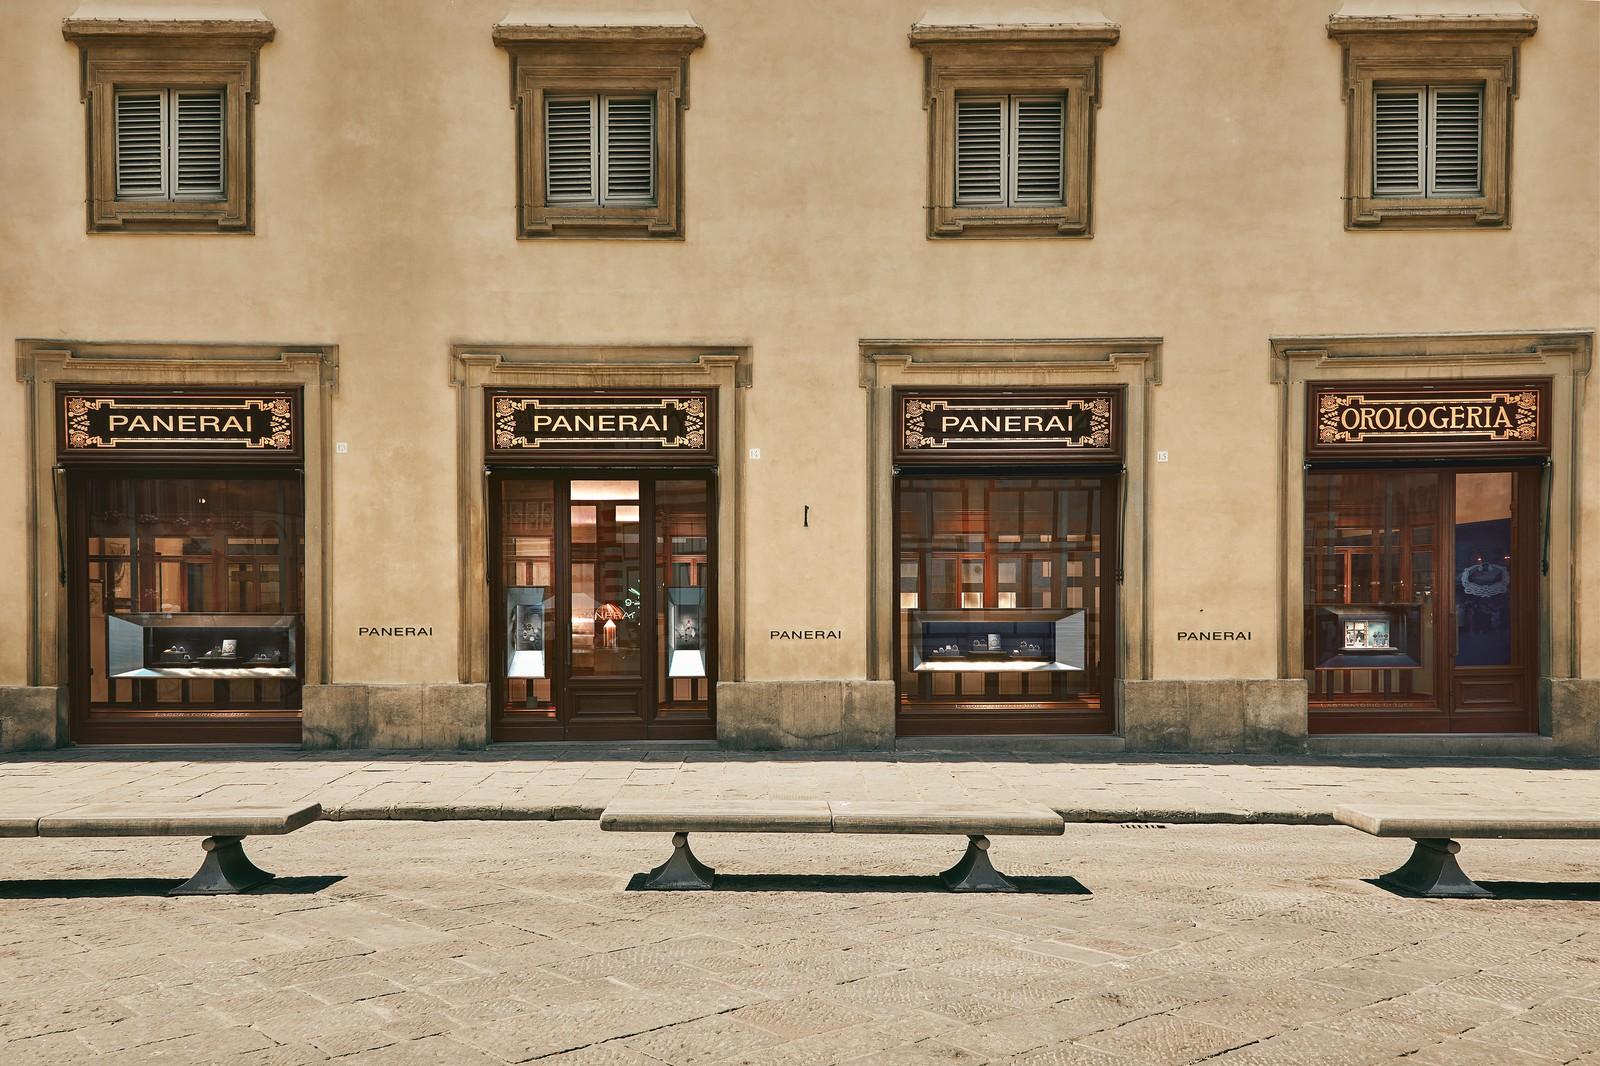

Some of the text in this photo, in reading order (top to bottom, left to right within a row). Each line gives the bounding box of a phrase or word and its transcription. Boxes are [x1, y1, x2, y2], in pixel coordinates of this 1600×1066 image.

[109, 415, 252, 432] PANERAI
[533, 415, 669, 432] PANERAI
[942, 415, 1074, 432] PANERAI
[1340, 406, 1514, 430] OROLOGERIA
[359, 627, 433, 637] PANERAI
[770, 630, 842, 640] PANERAI
[1178, 631, 1251, 641] PANERAI
